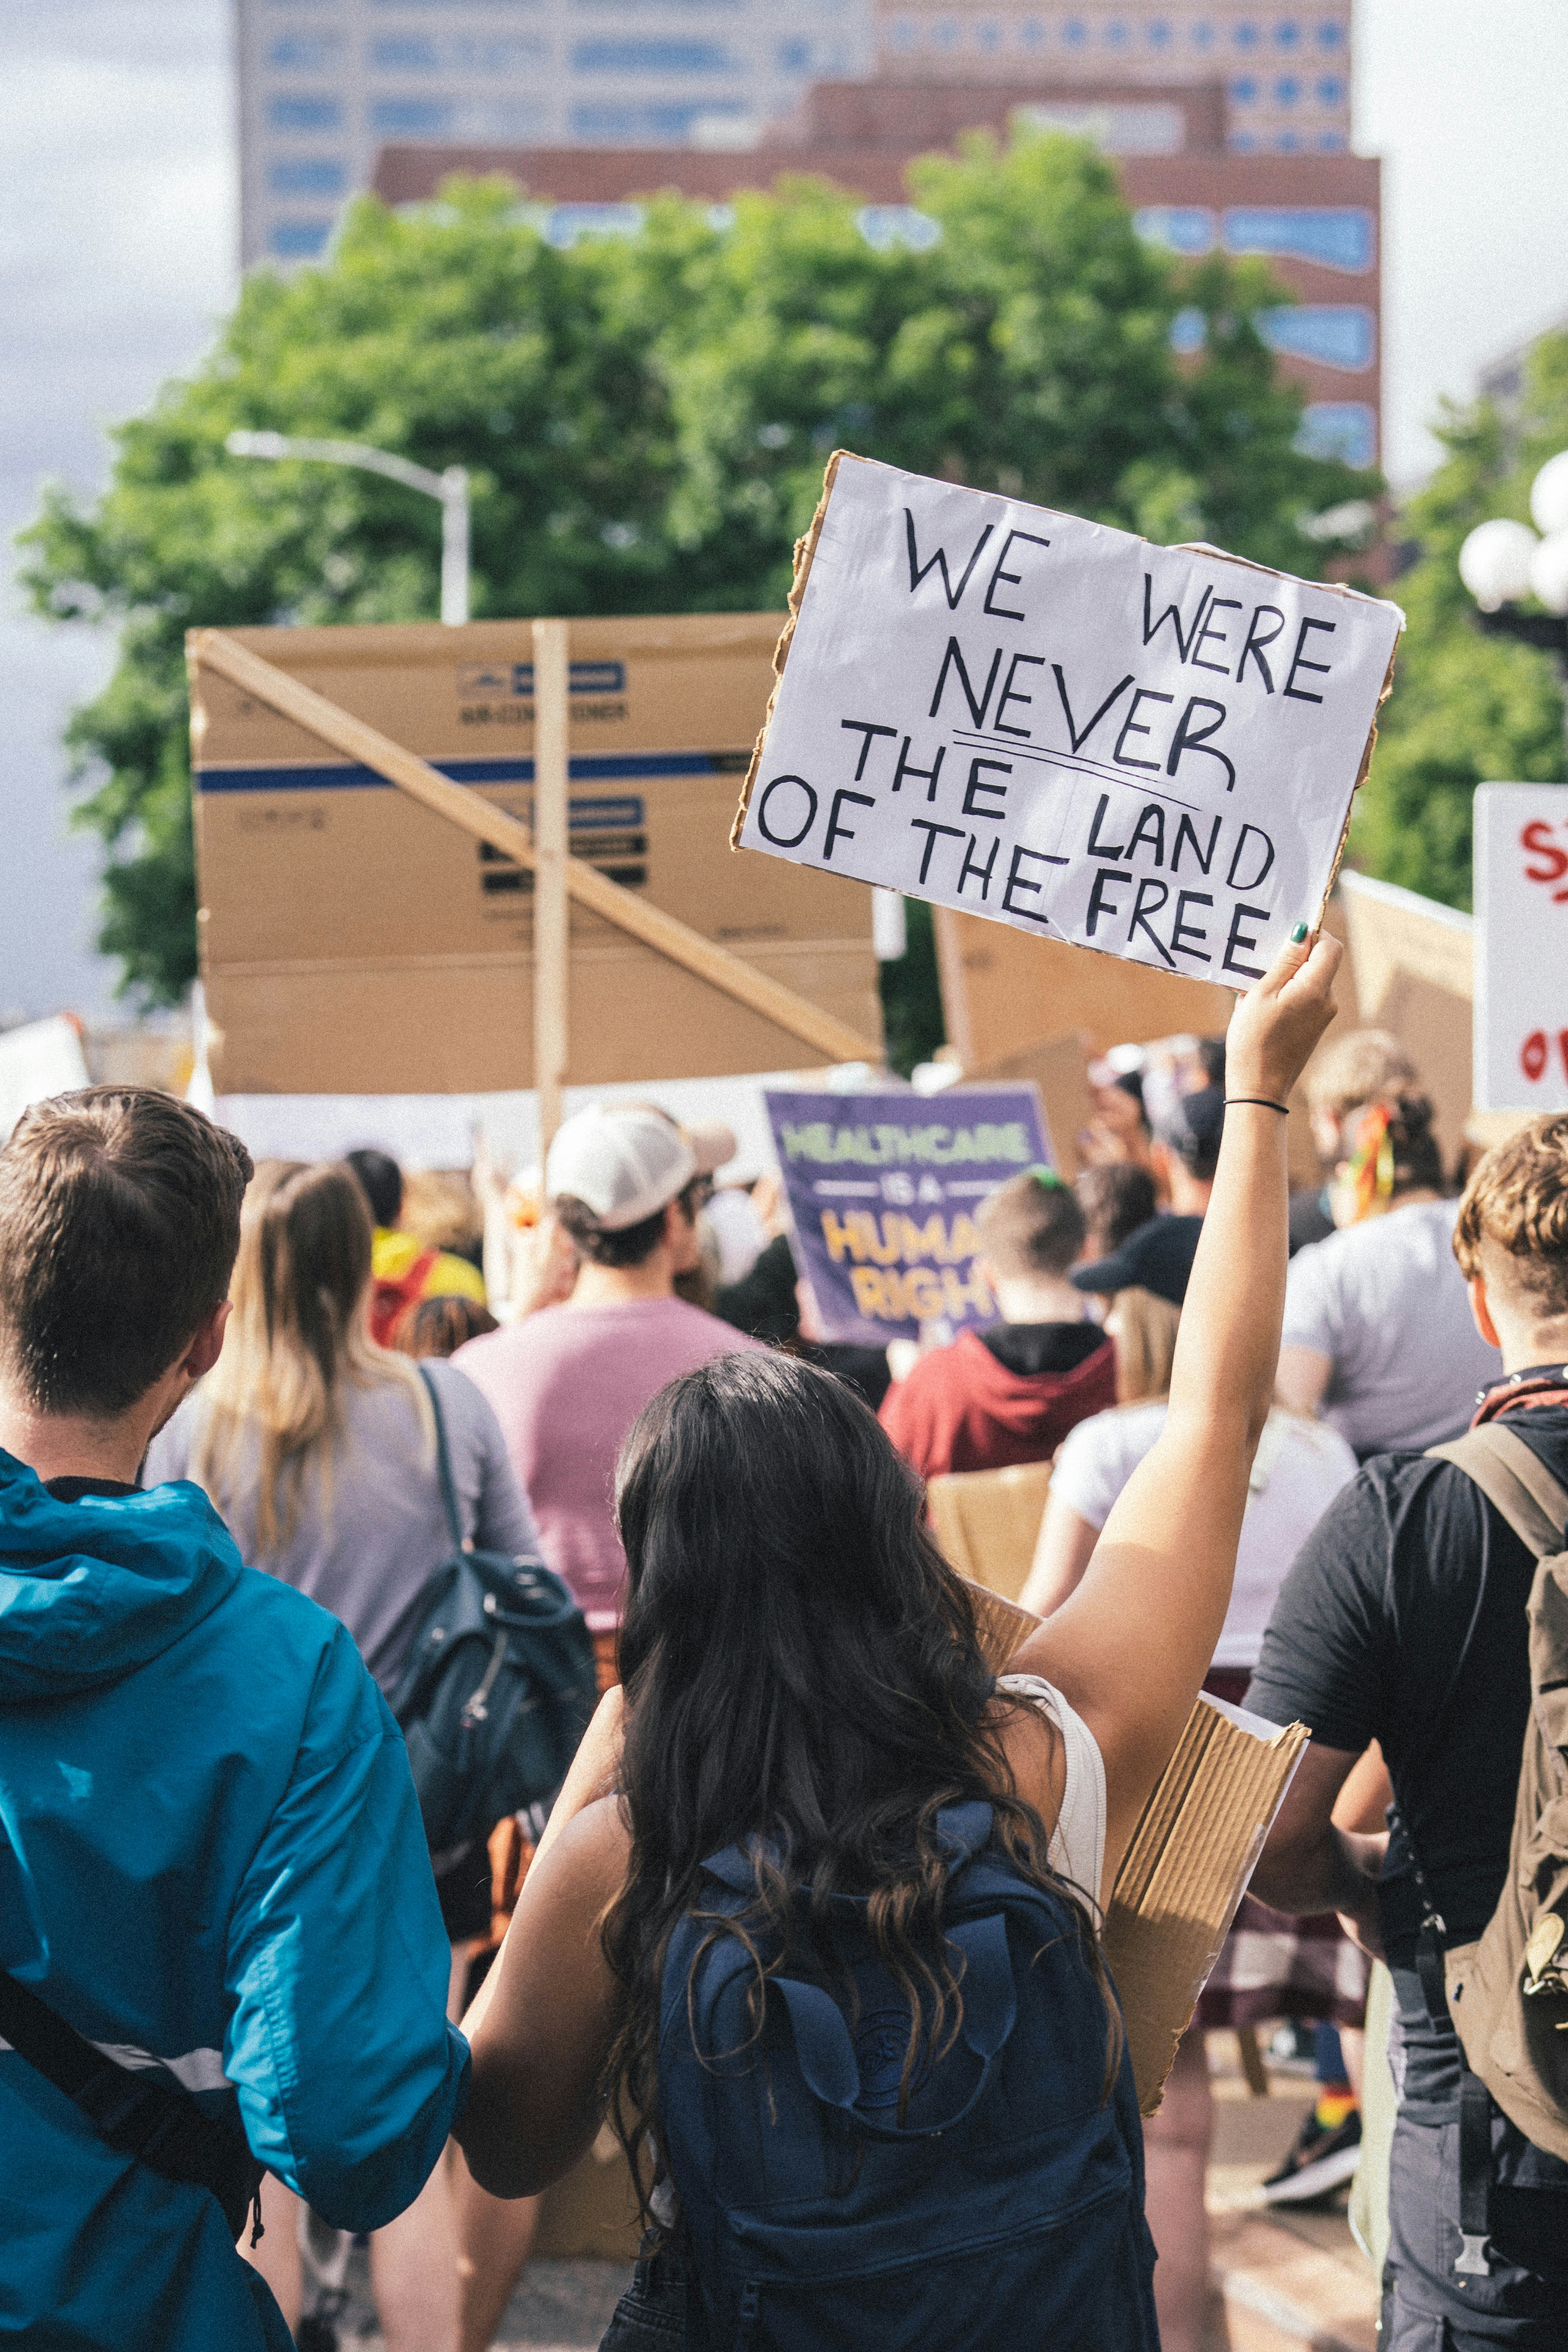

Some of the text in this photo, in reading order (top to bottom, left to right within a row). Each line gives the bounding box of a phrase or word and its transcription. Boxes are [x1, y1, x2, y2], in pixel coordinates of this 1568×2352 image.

[905, 508, 1336, 704] WE WERE
[929, 636, 1236, 791] NEVER
[841, 719, 1275, 890] THE LAND
[758, 775, 1270, 978] OF THE FREE
[783, 1123, 1033, 1164] HEALTHCARE
[881, 1172, 943, 1204] IS A
[820, 1209, 982, 1265] HUMA
[850, 1266, 996, 1320] RIGH
